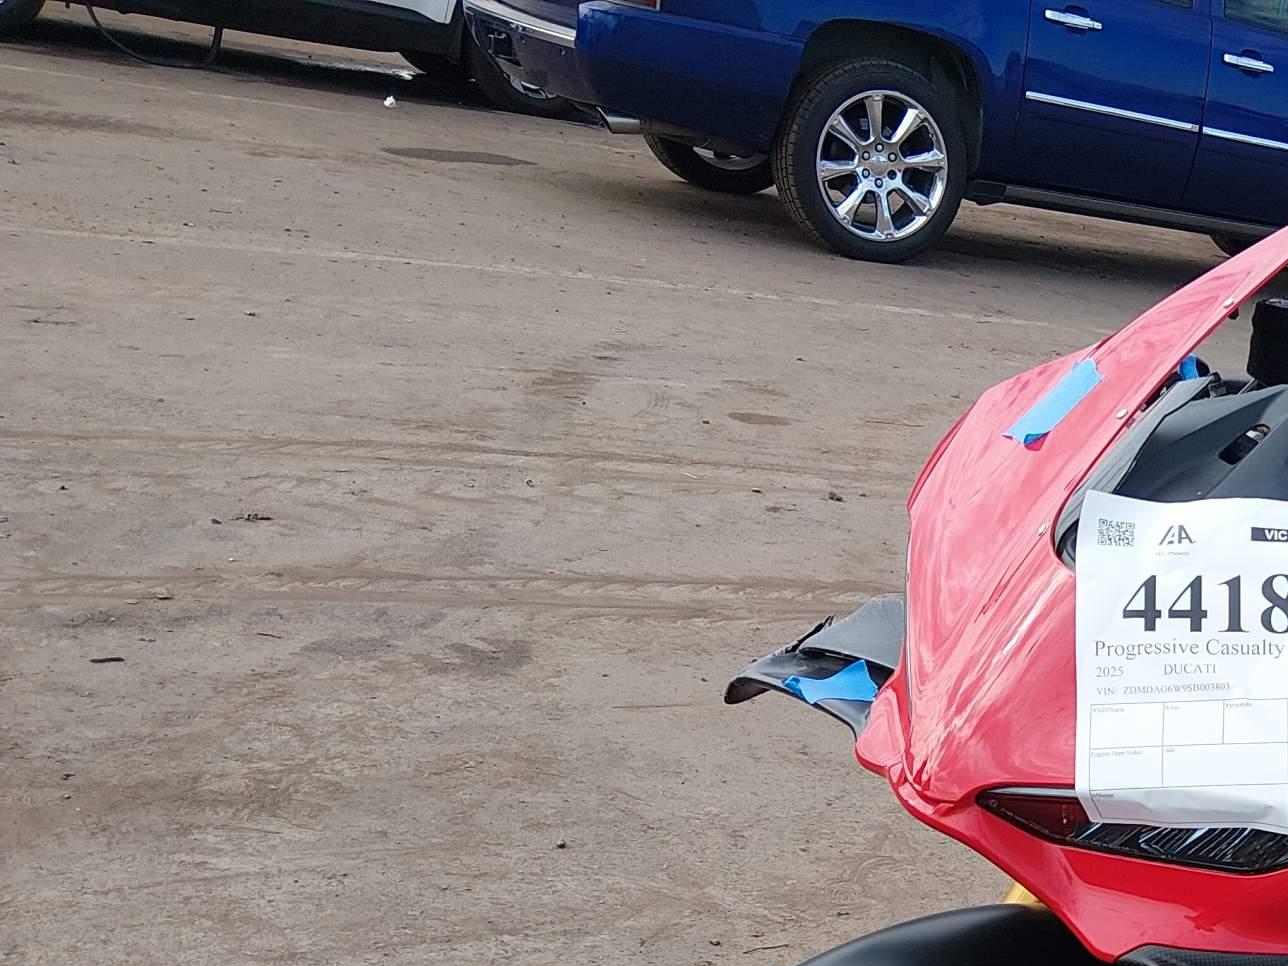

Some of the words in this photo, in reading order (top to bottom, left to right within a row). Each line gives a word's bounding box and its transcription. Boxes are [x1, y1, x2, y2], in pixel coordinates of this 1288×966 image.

[1264, 529, 1288, 541] VIC
[1095, 638, 1199, 660] Progressive
[1206, 638, 1285, 659] Casualty
[1095, 666, 1124, 678] 2025
[1163, 663, 1216, 676] DUCATI
